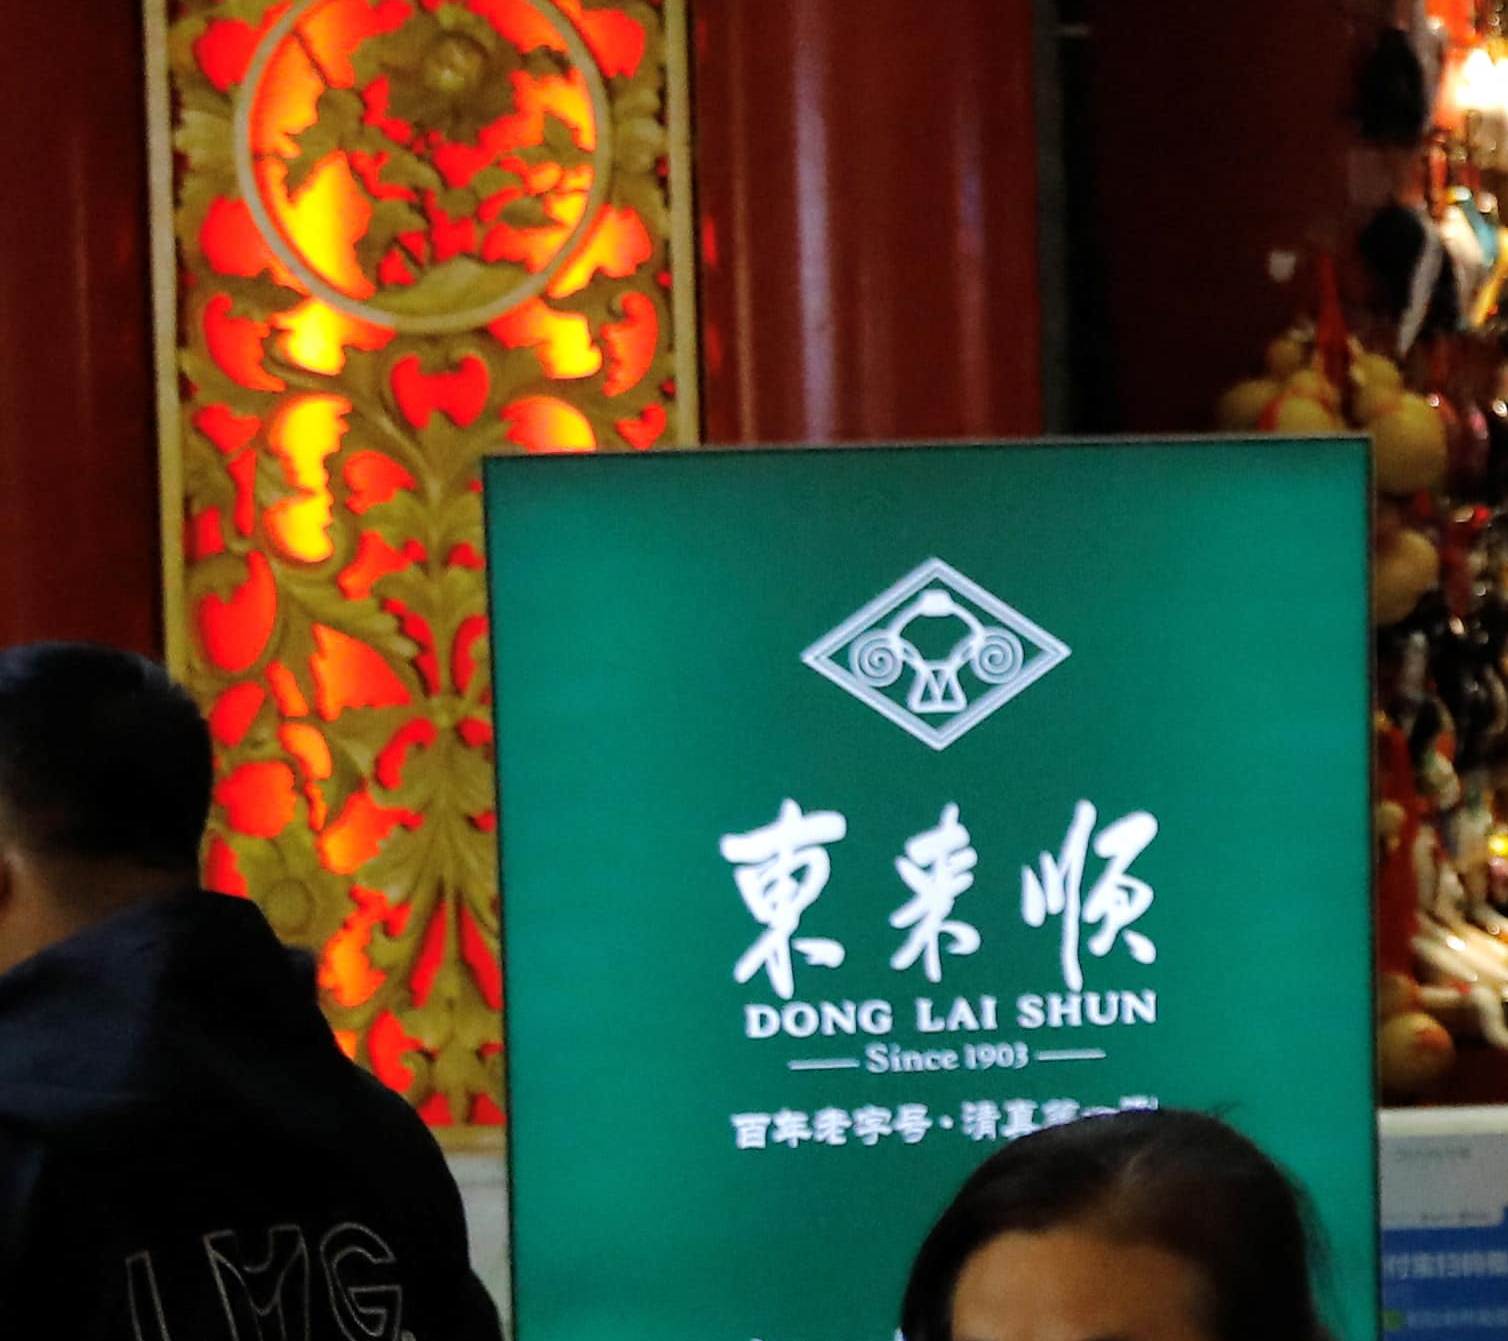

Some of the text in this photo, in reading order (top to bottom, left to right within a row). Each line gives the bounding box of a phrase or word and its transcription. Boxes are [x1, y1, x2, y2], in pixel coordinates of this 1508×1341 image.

[744, 990, 1157, 1038] DONG LAI SHUN
[865, 1041, 1029, 1073] Since 1903
